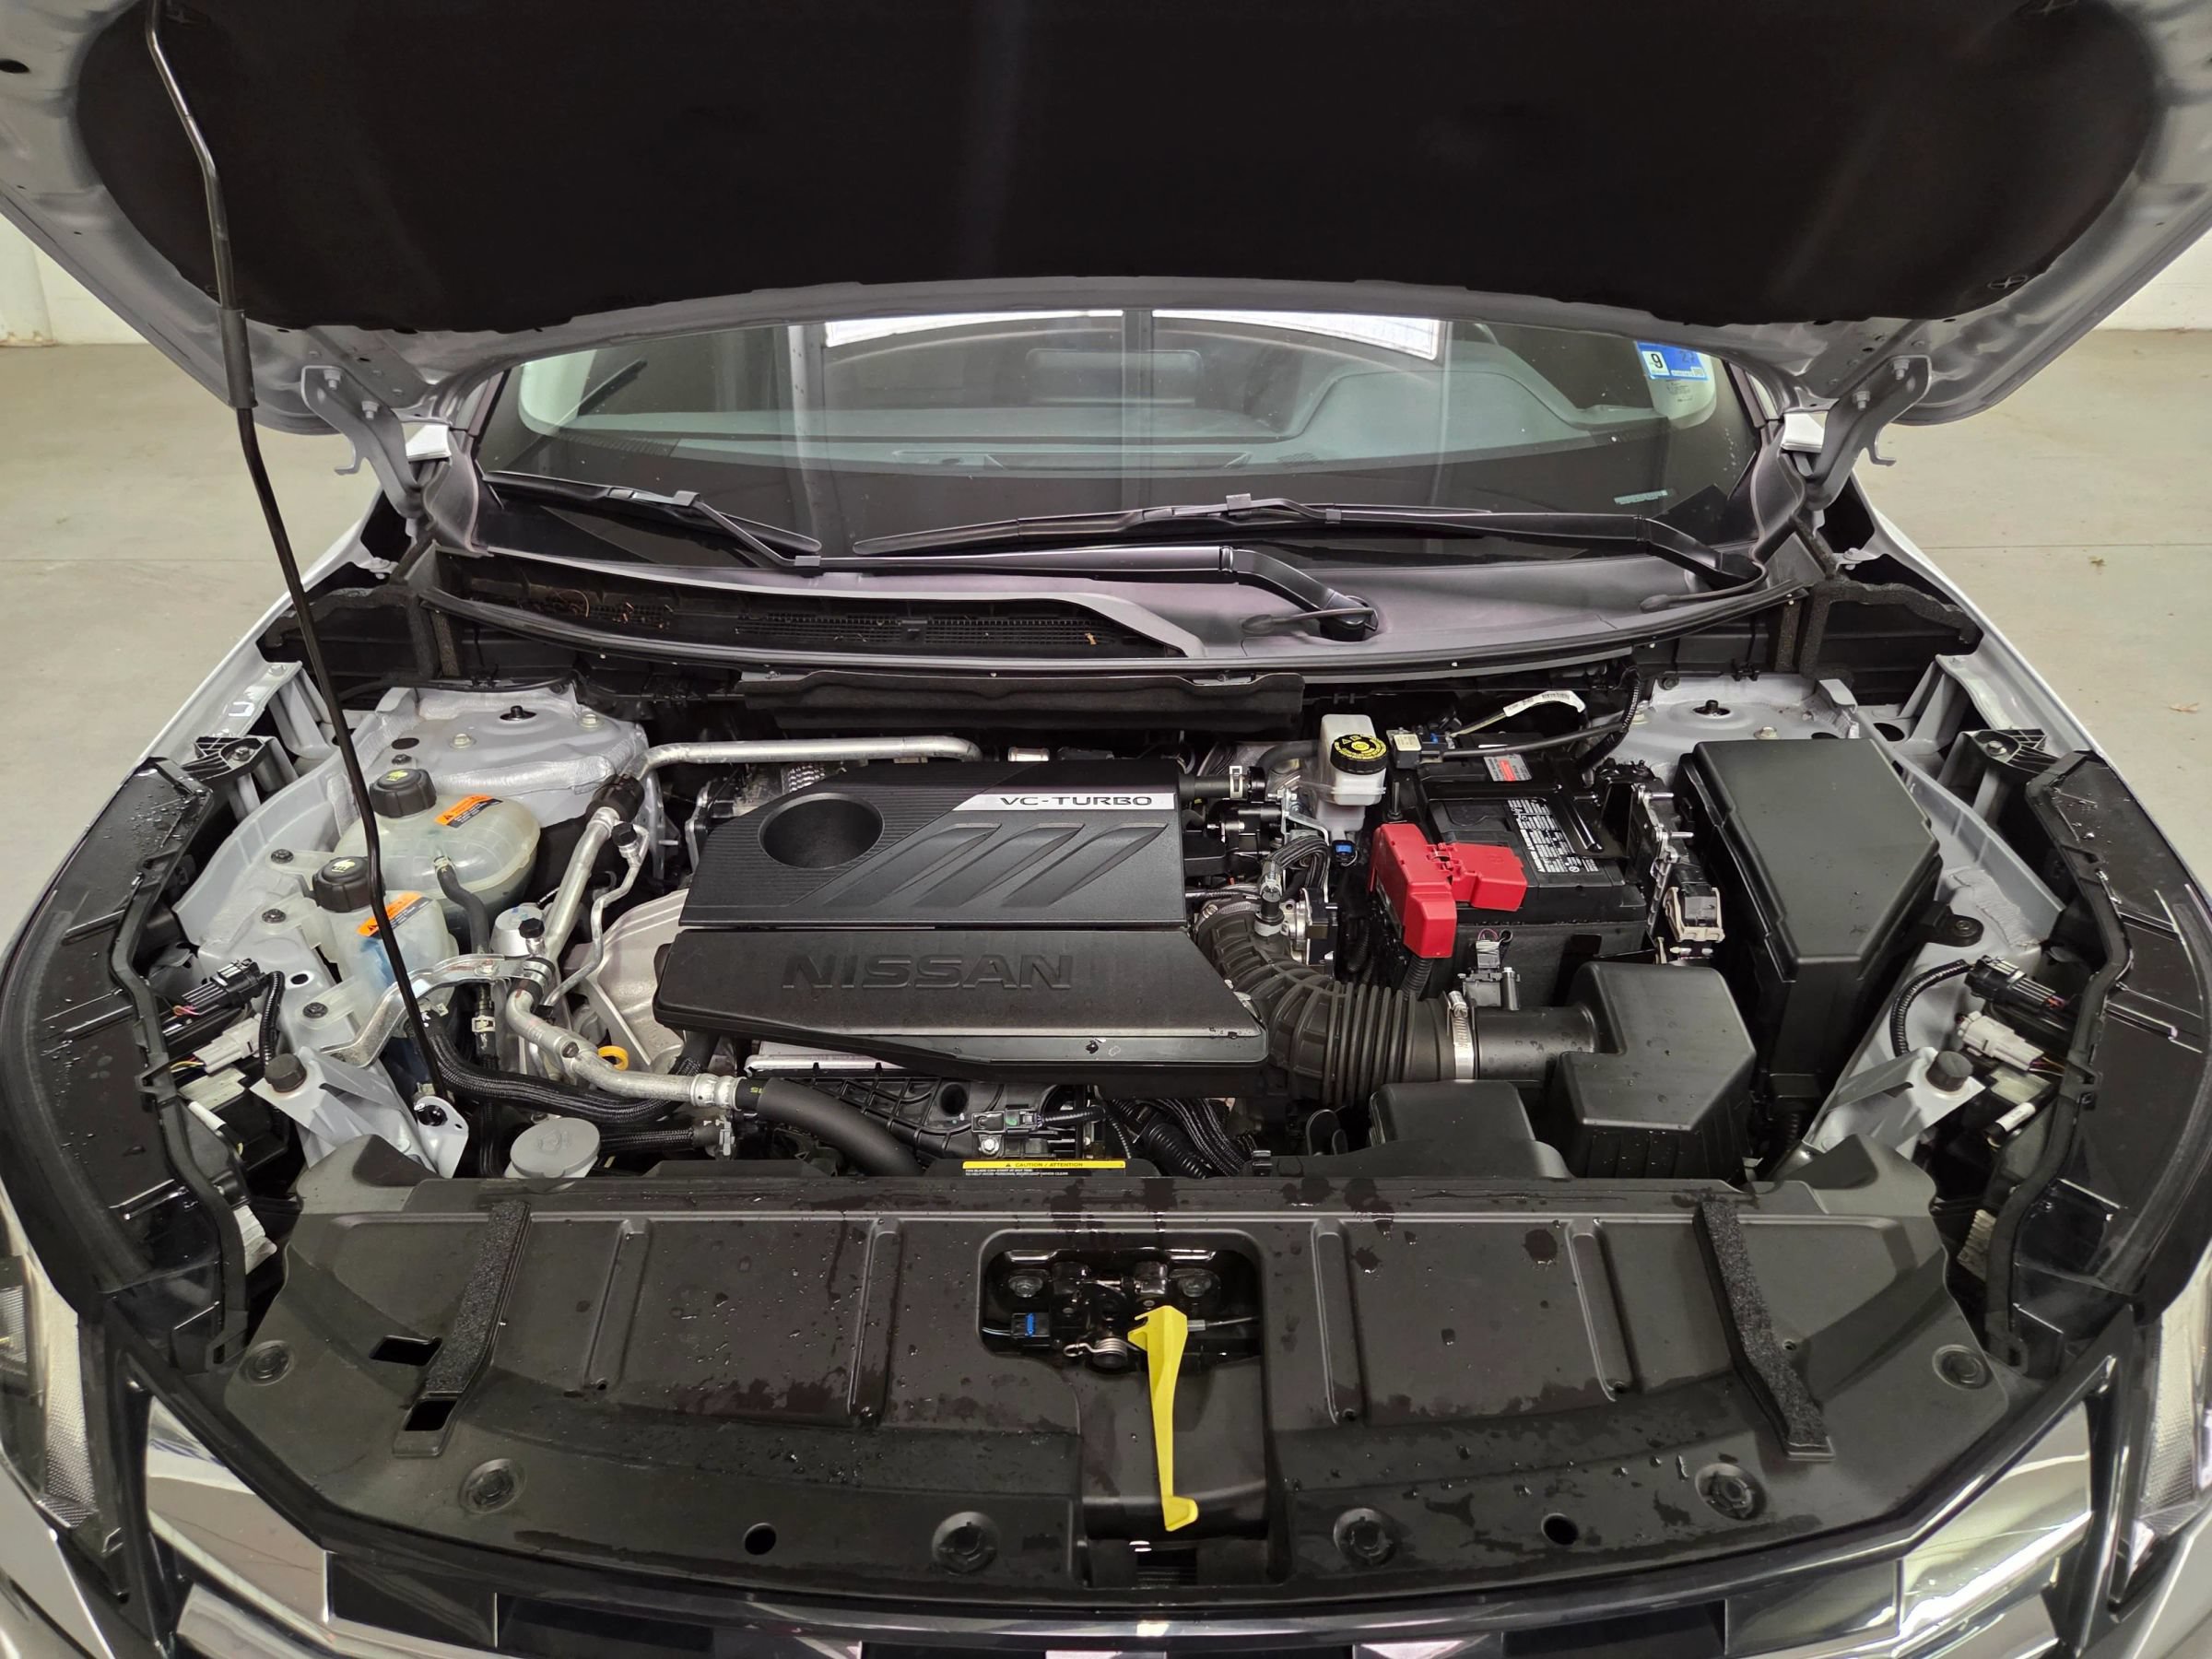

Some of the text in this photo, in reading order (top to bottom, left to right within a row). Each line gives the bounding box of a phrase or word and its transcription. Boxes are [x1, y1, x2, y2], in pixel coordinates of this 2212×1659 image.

[1651, 353, 1664, 369] 9
[1000, 796, 1152, 806] VC-TURBO
[782, 953, 1074, 989] NISSAN
